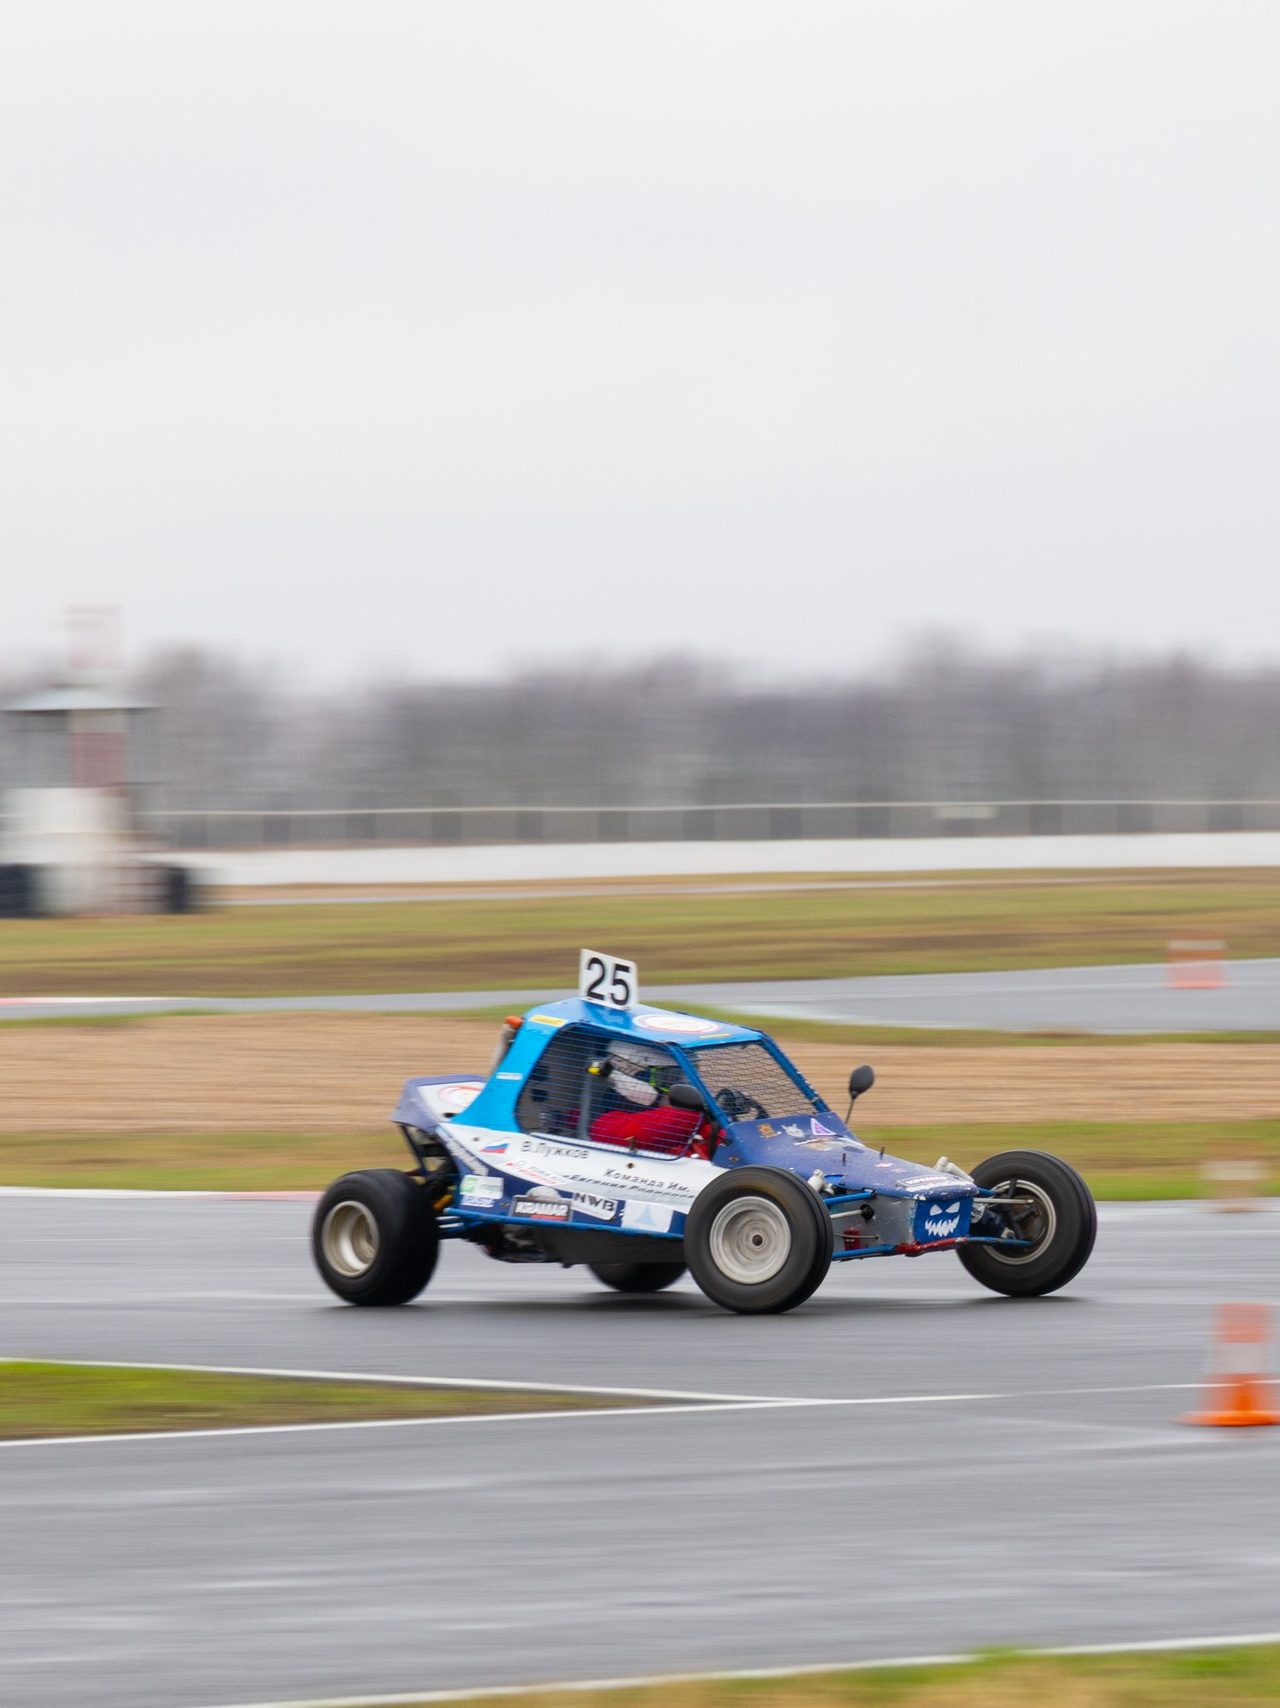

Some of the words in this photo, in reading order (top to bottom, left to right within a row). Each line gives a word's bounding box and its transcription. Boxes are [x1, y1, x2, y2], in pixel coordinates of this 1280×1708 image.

[586, 957, 630, 1006] 25
[604, 1168, 664, 1188] Команда
[666, 1181, 691, 1193] Им.
[574, 1192, 615, 1212] NWB
[629, 1185, 695, 1199] Родионов
